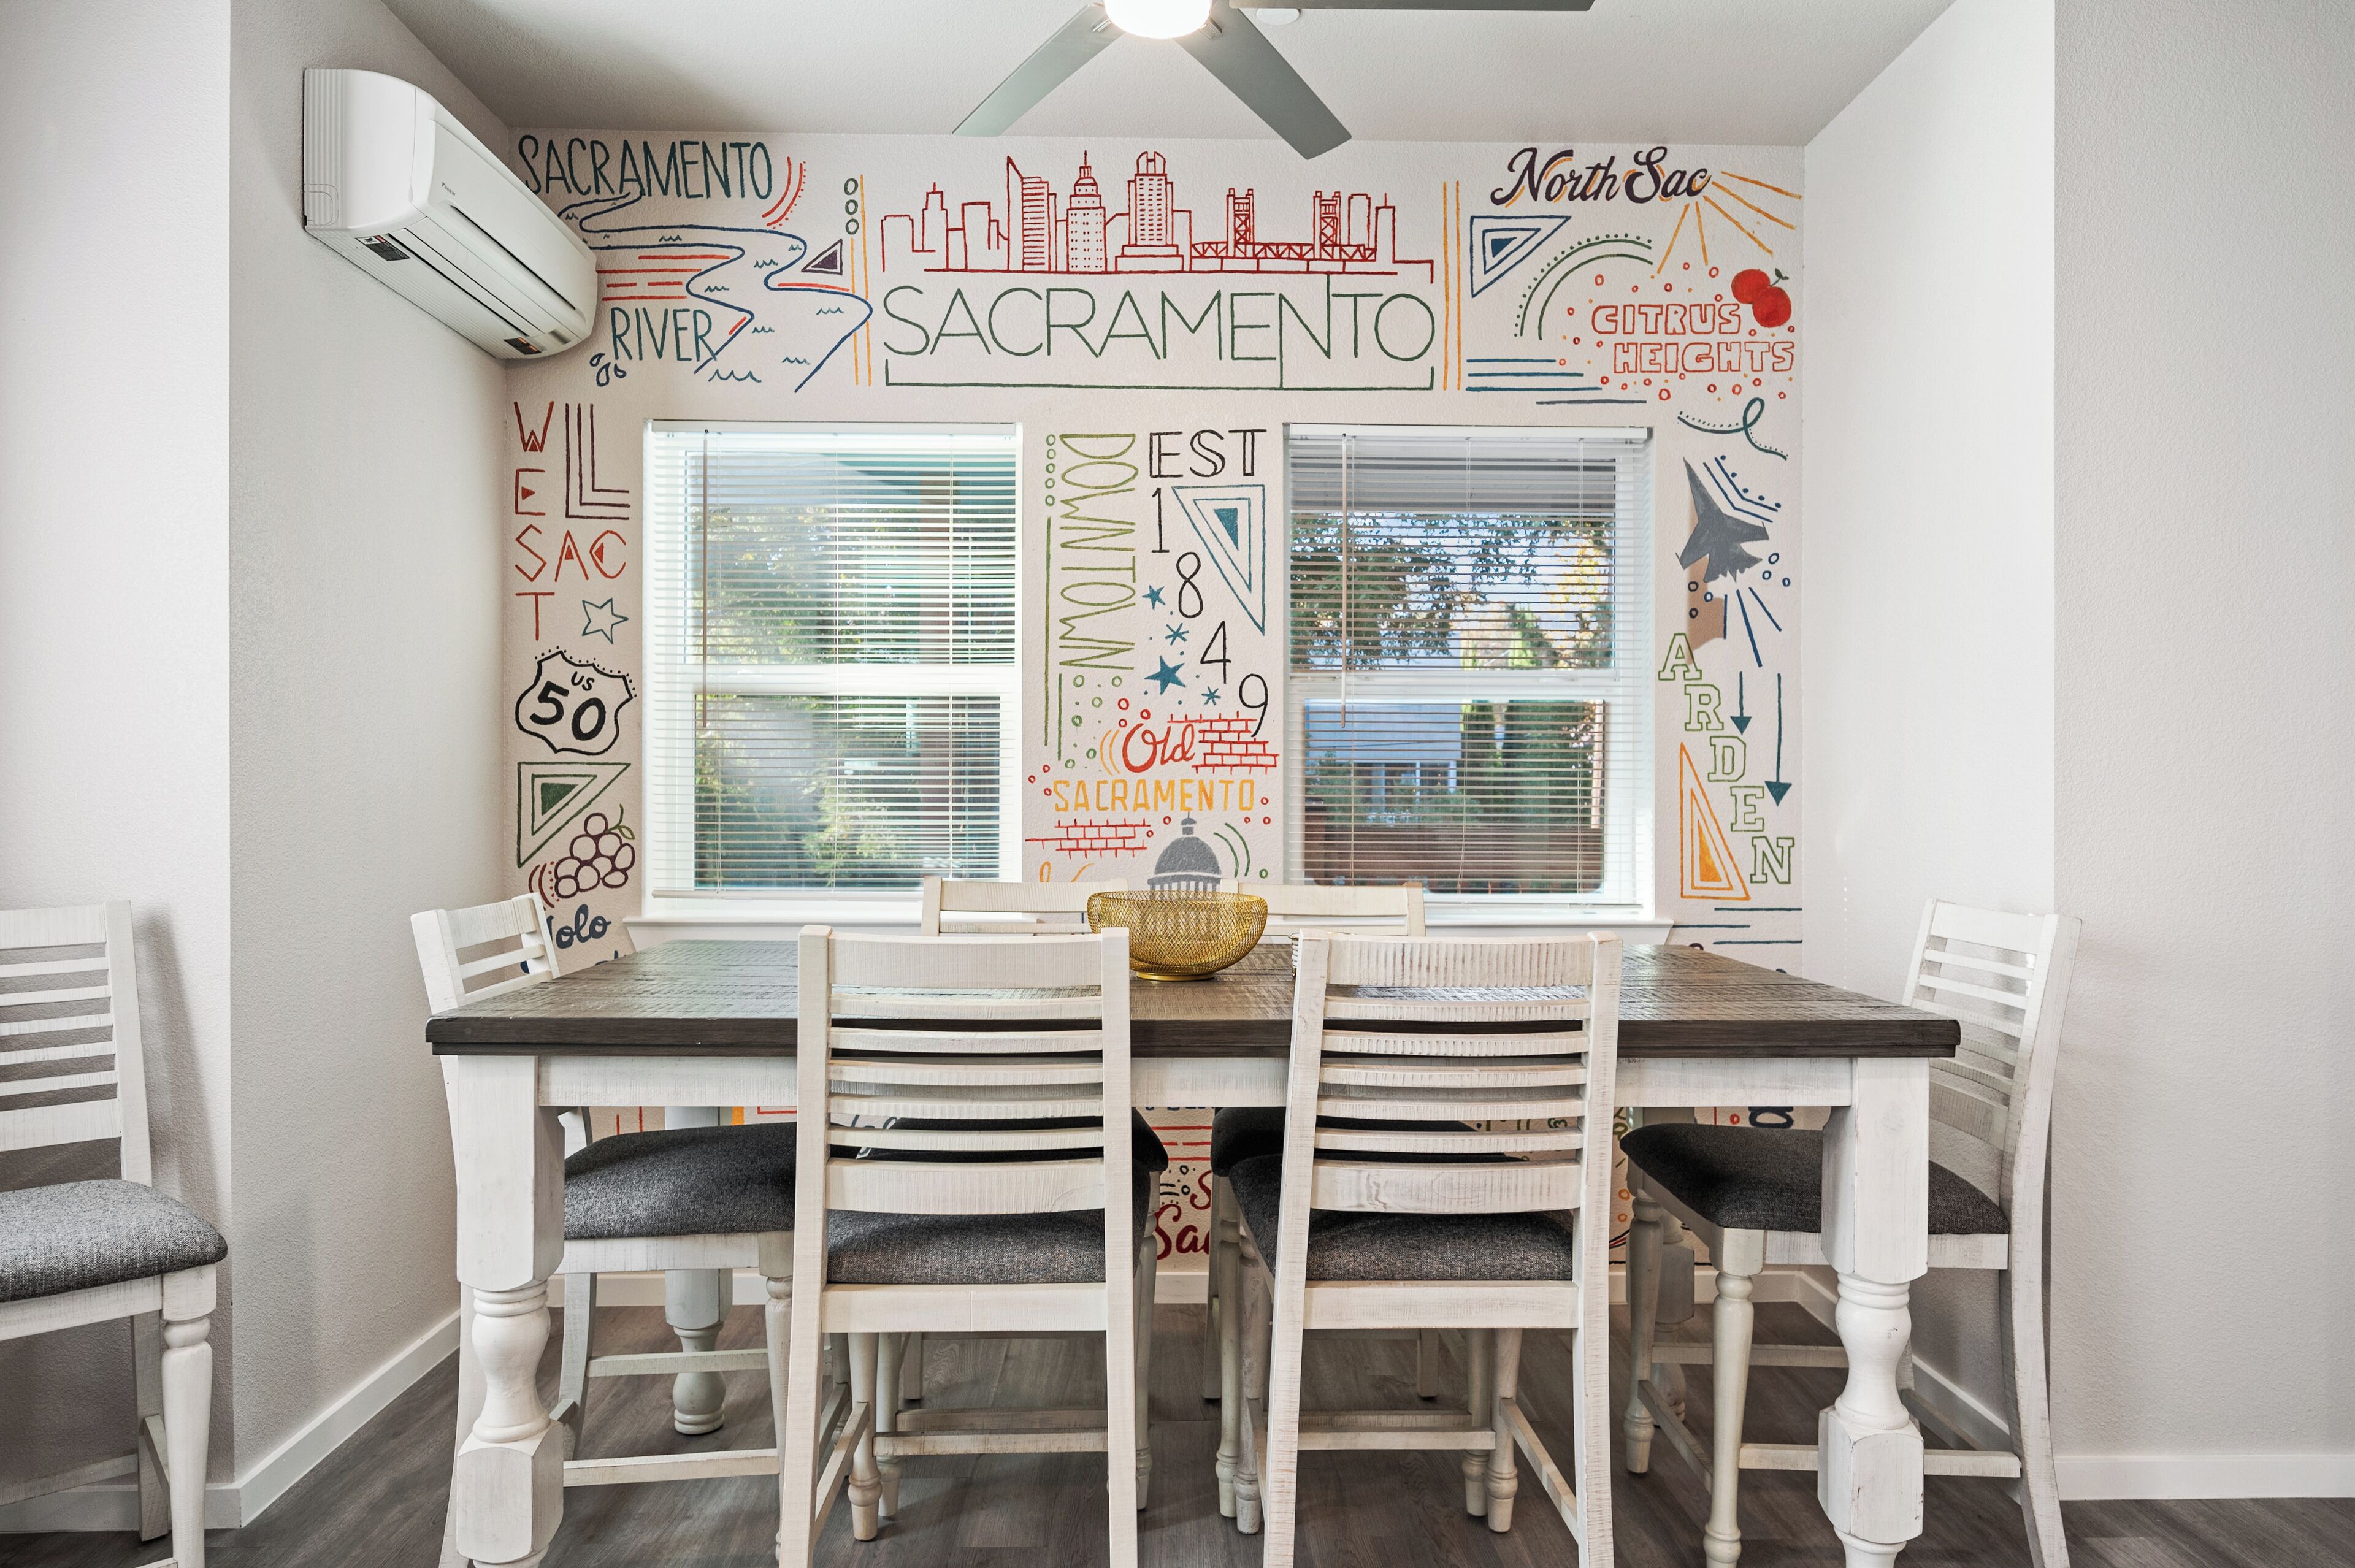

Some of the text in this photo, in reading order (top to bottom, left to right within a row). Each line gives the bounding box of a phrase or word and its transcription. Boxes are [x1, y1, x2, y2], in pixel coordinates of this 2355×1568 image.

[519, 135, 772, 200] SACRAMENTO
[1490, 146, 1712, 205] North Sac
[611, 307, 718, 362] RIVER
[884, 283, 1435, 363] SACRAMENTO
[1591, 302, 1741, 335] CITRUS
[1614, 341, 1795, 373] HEIGHTS
[1150, 429, 1267, 478] EST
[1059, 433, 1139, 671] DOWNTOWN
[571, 671, 595, 691] US
[530, 680, 606, 741] 50
[1122, 723, 1195, 773] Old
[1658, 633, 1794, 884] ARDEN
[1053, 779, 1255, 812] SACRAMENTO
